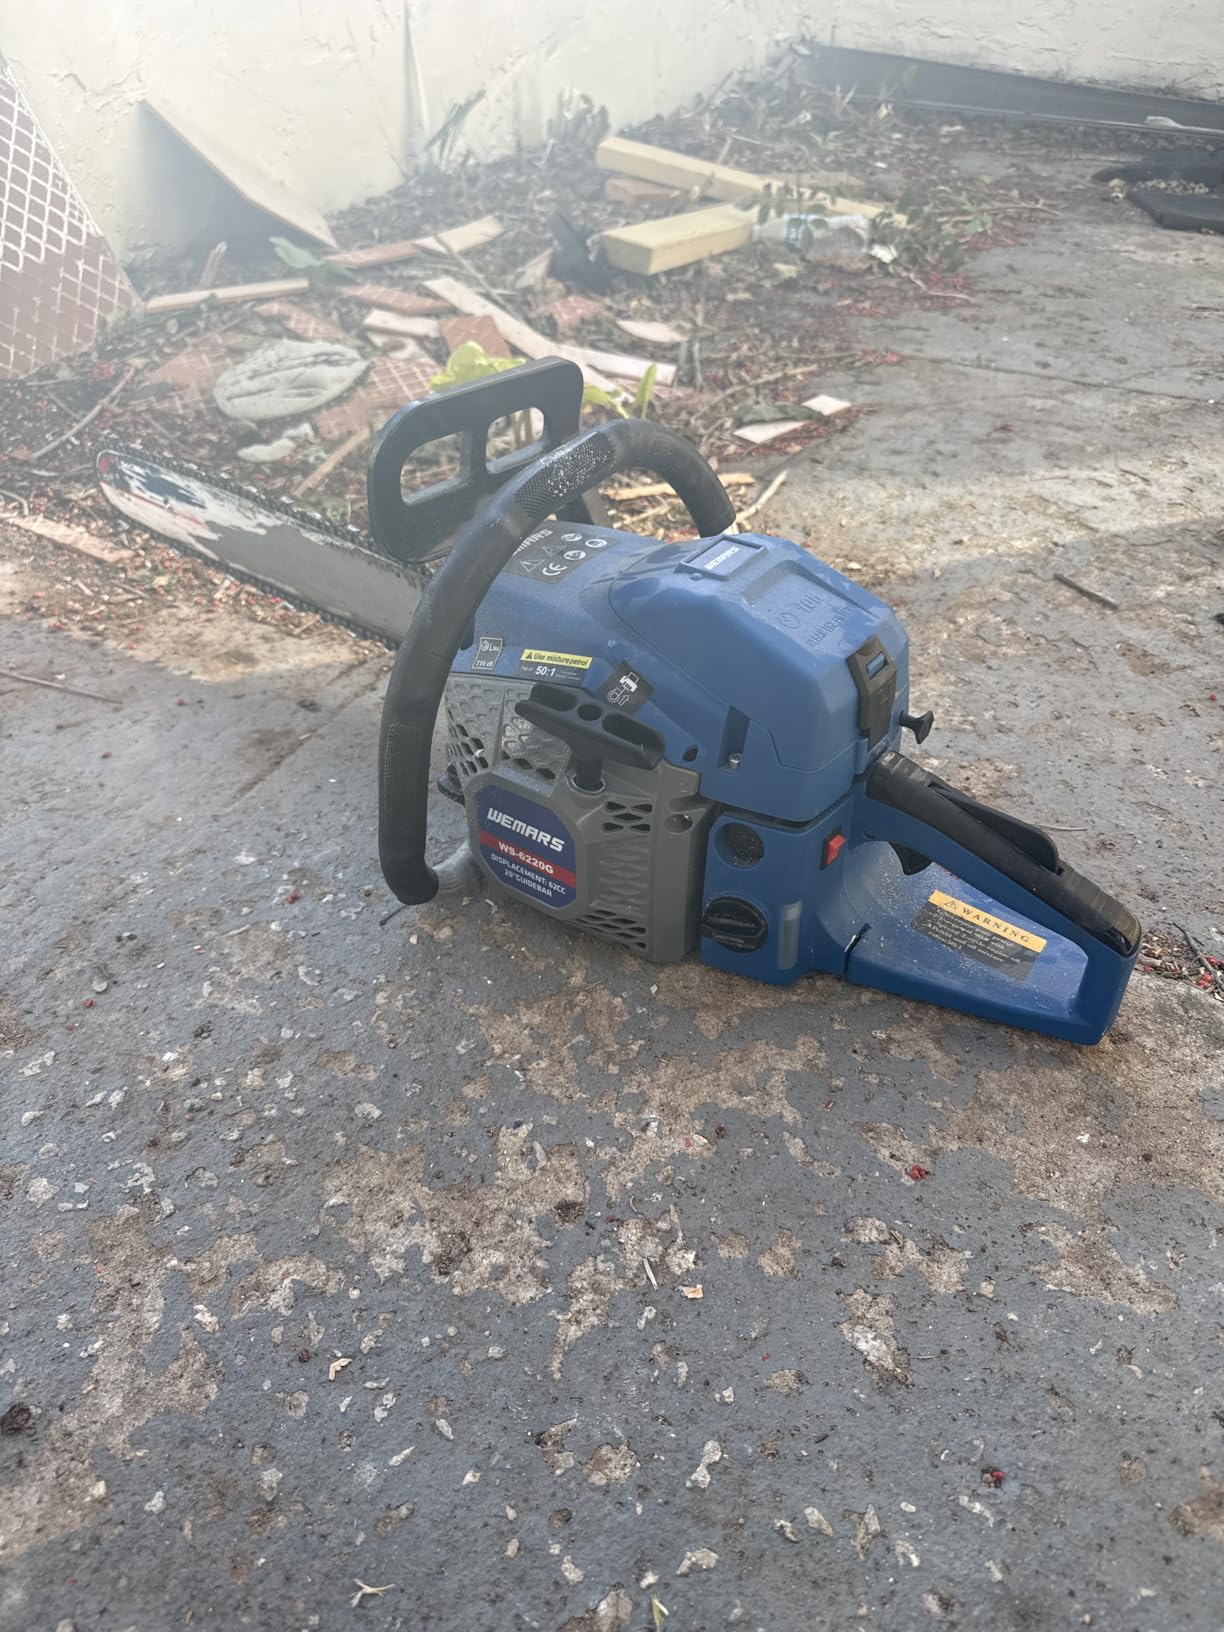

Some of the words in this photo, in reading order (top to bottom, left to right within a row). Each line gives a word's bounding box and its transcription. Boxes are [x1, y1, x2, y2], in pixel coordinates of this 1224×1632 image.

[512, 529, 553, 557] MARS
[704, 545, 740, 570] WEMARS
[534, 652, 545, 660] Use
[546, 654, 570, 664] mixture
[569, 658, 589, 666] petrol
[535, 665, 556, 677] 50:1
[487, 807, 565, 852] WEMARS
[498, 841, 554, 875] WS-6220G
[491, 853, 548, 886] DISPLACEMENT:
[548, 881, 567, 895] 62CC
[963, 907, 1030, 942] WARNING
